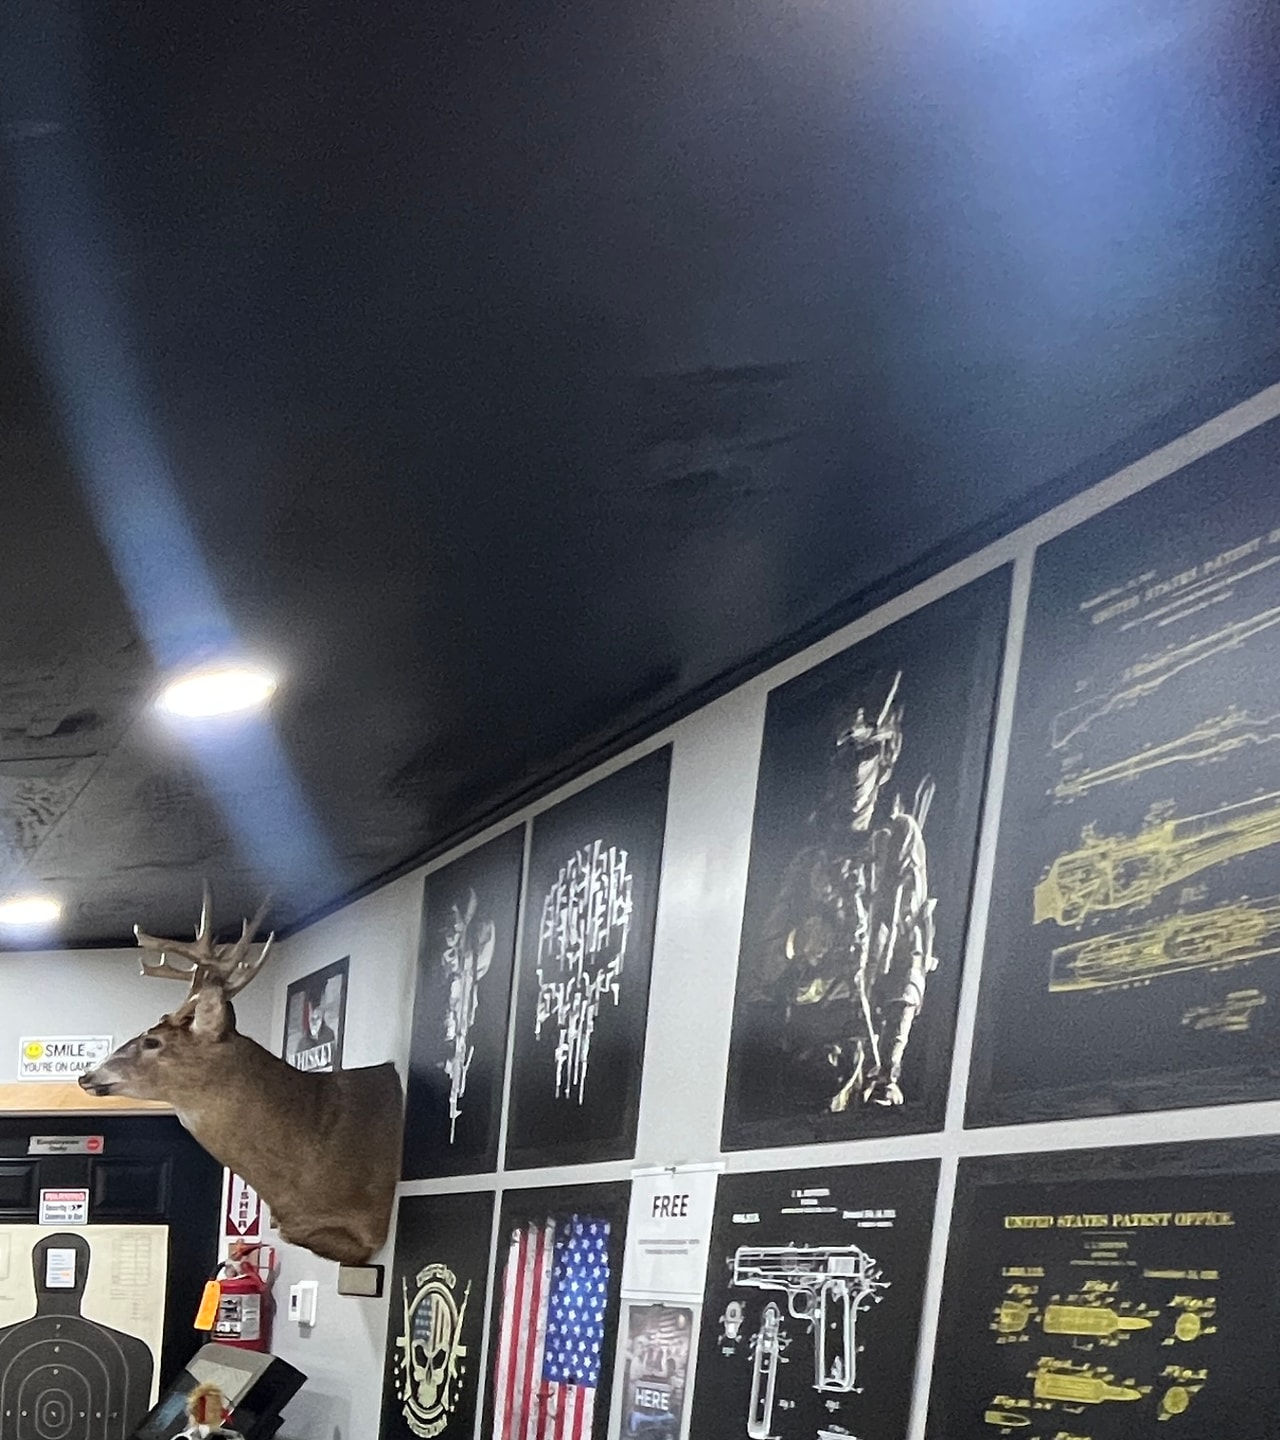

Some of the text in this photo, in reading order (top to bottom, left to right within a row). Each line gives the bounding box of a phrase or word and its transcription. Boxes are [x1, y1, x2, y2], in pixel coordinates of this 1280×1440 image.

[45, 1044, 85, 1057] SMILE
[24, 1062, 53, 1072] YOU'RE
[56, 1062, 68, 1072] ON
[652, 1194, 689, 1218] FREE
[1005, 1216, 1054, 1228] UNITED
[1057, 1214, 1109, 1227] STATES
[1112, 1213, 1172, 1227] PATENT
[635, 1389, 669, 1411] HERE
